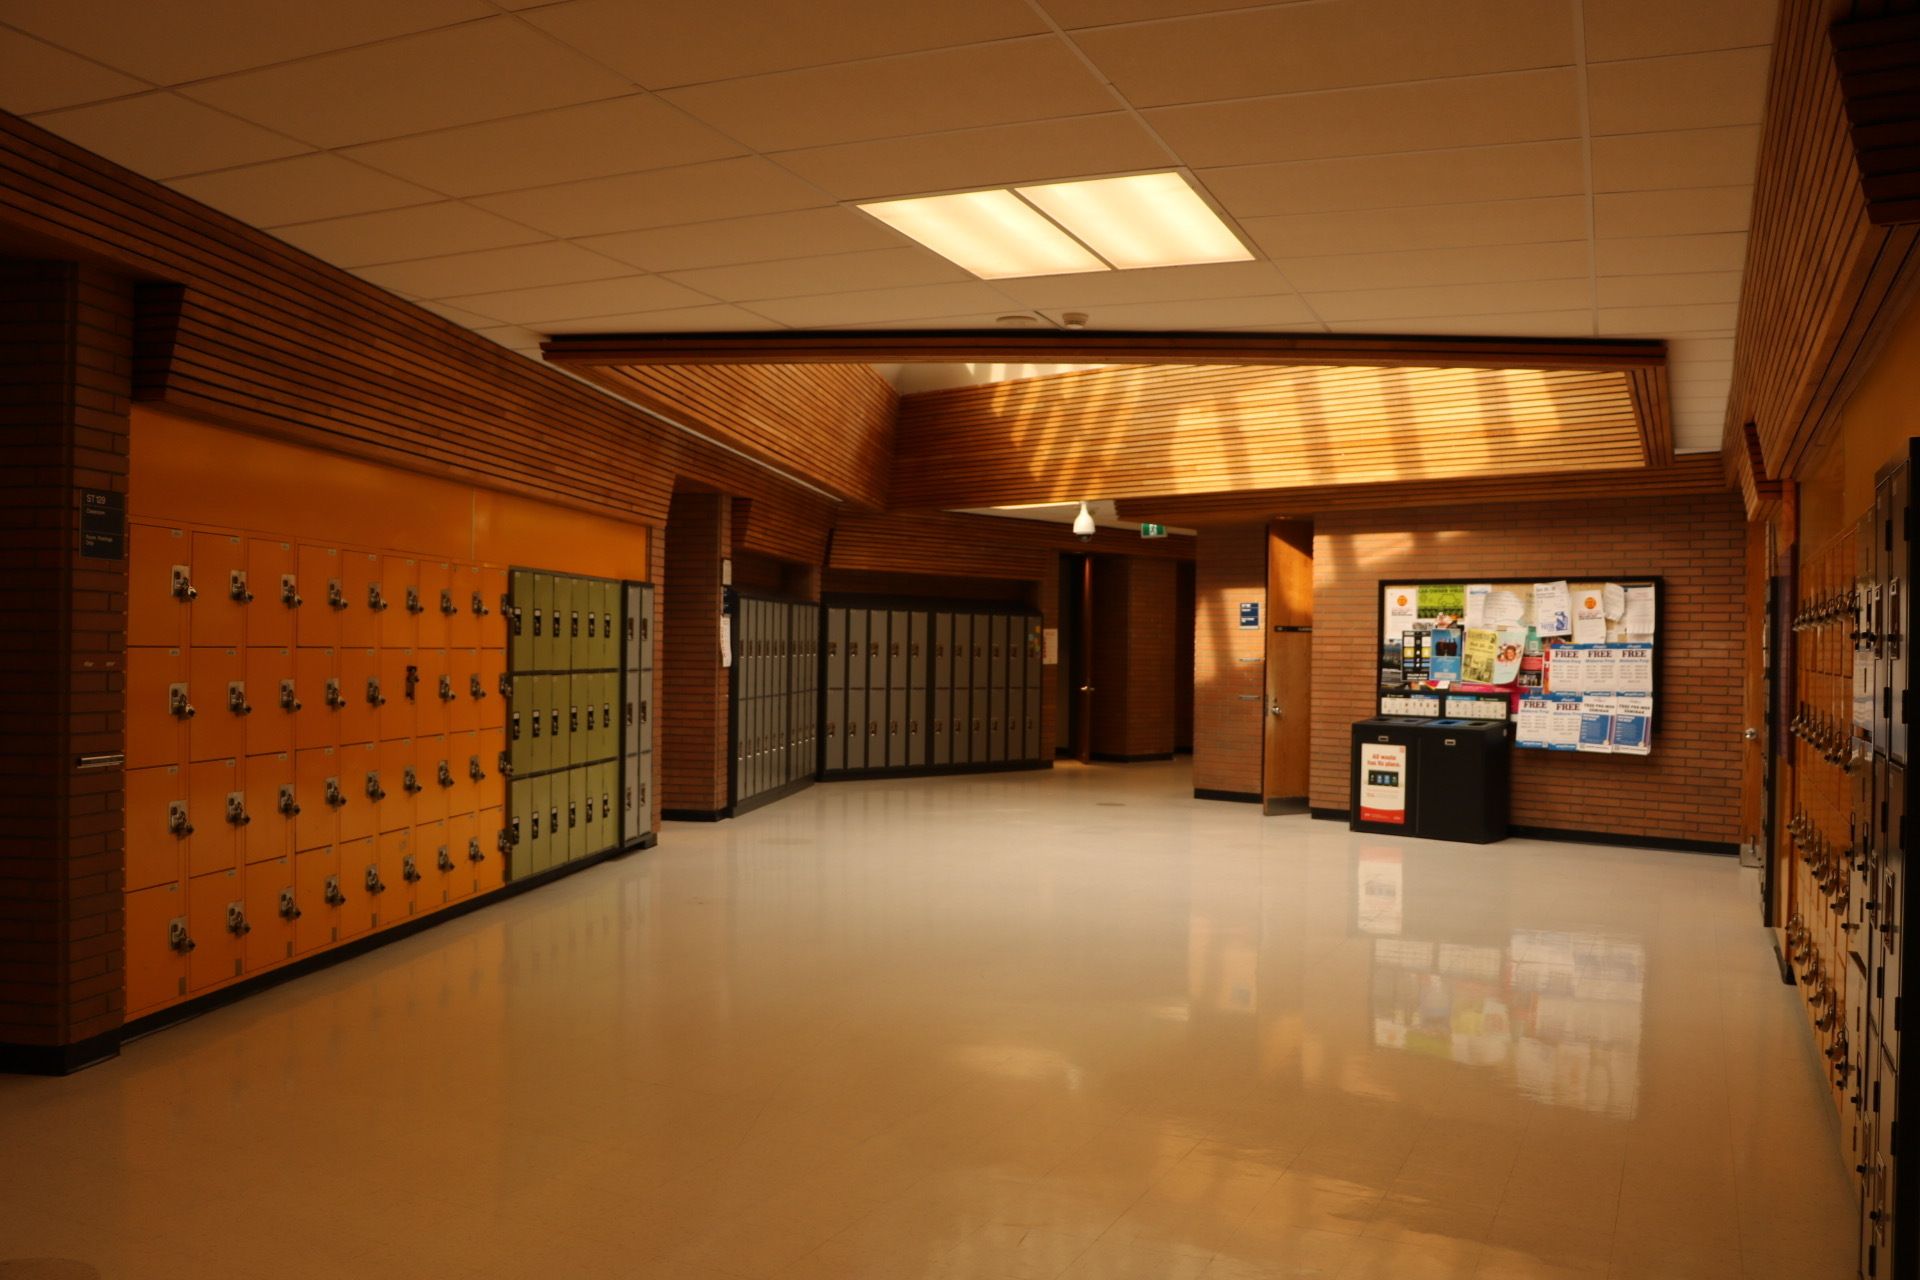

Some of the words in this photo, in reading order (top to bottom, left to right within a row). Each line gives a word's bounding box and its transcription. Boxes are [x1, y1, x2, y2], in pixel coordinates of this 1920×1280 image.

[86, 494, 95, 503] ST
[1588, 650, 1613, 658] FREE
[1523, 701, 1547, 709] FREE
